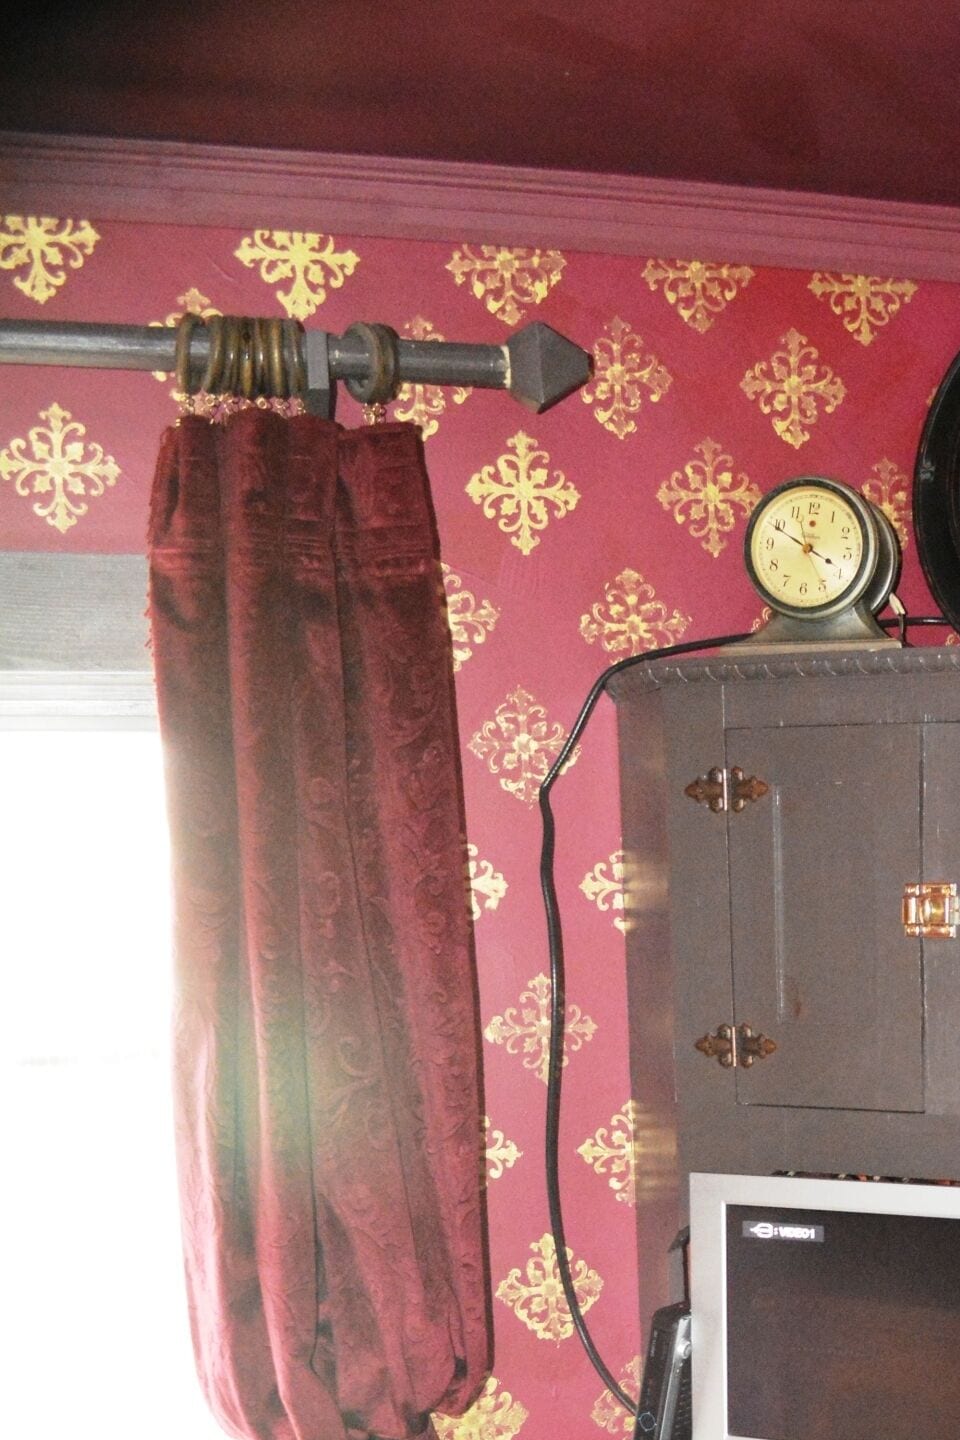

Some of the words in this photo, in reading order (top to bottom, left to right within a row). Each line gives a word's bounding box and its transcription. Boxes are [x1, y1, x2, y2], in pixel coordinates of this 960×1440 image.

[792, 506, 800, 519] 11
[808, 502, 820, 515] 12
[831, 511, 835, 524] 1
[775, 519, 785, 531] 10
[841, 526, 850, 540] 2
[766, 537, 774, 551] 9
[843, 547, 852, 561] 3
[769, 559, 778, 572] 8
[783, 574, 791, 587] 7
[818, 580, 826, 592] 5
[799, 582, 807, 595] 6
